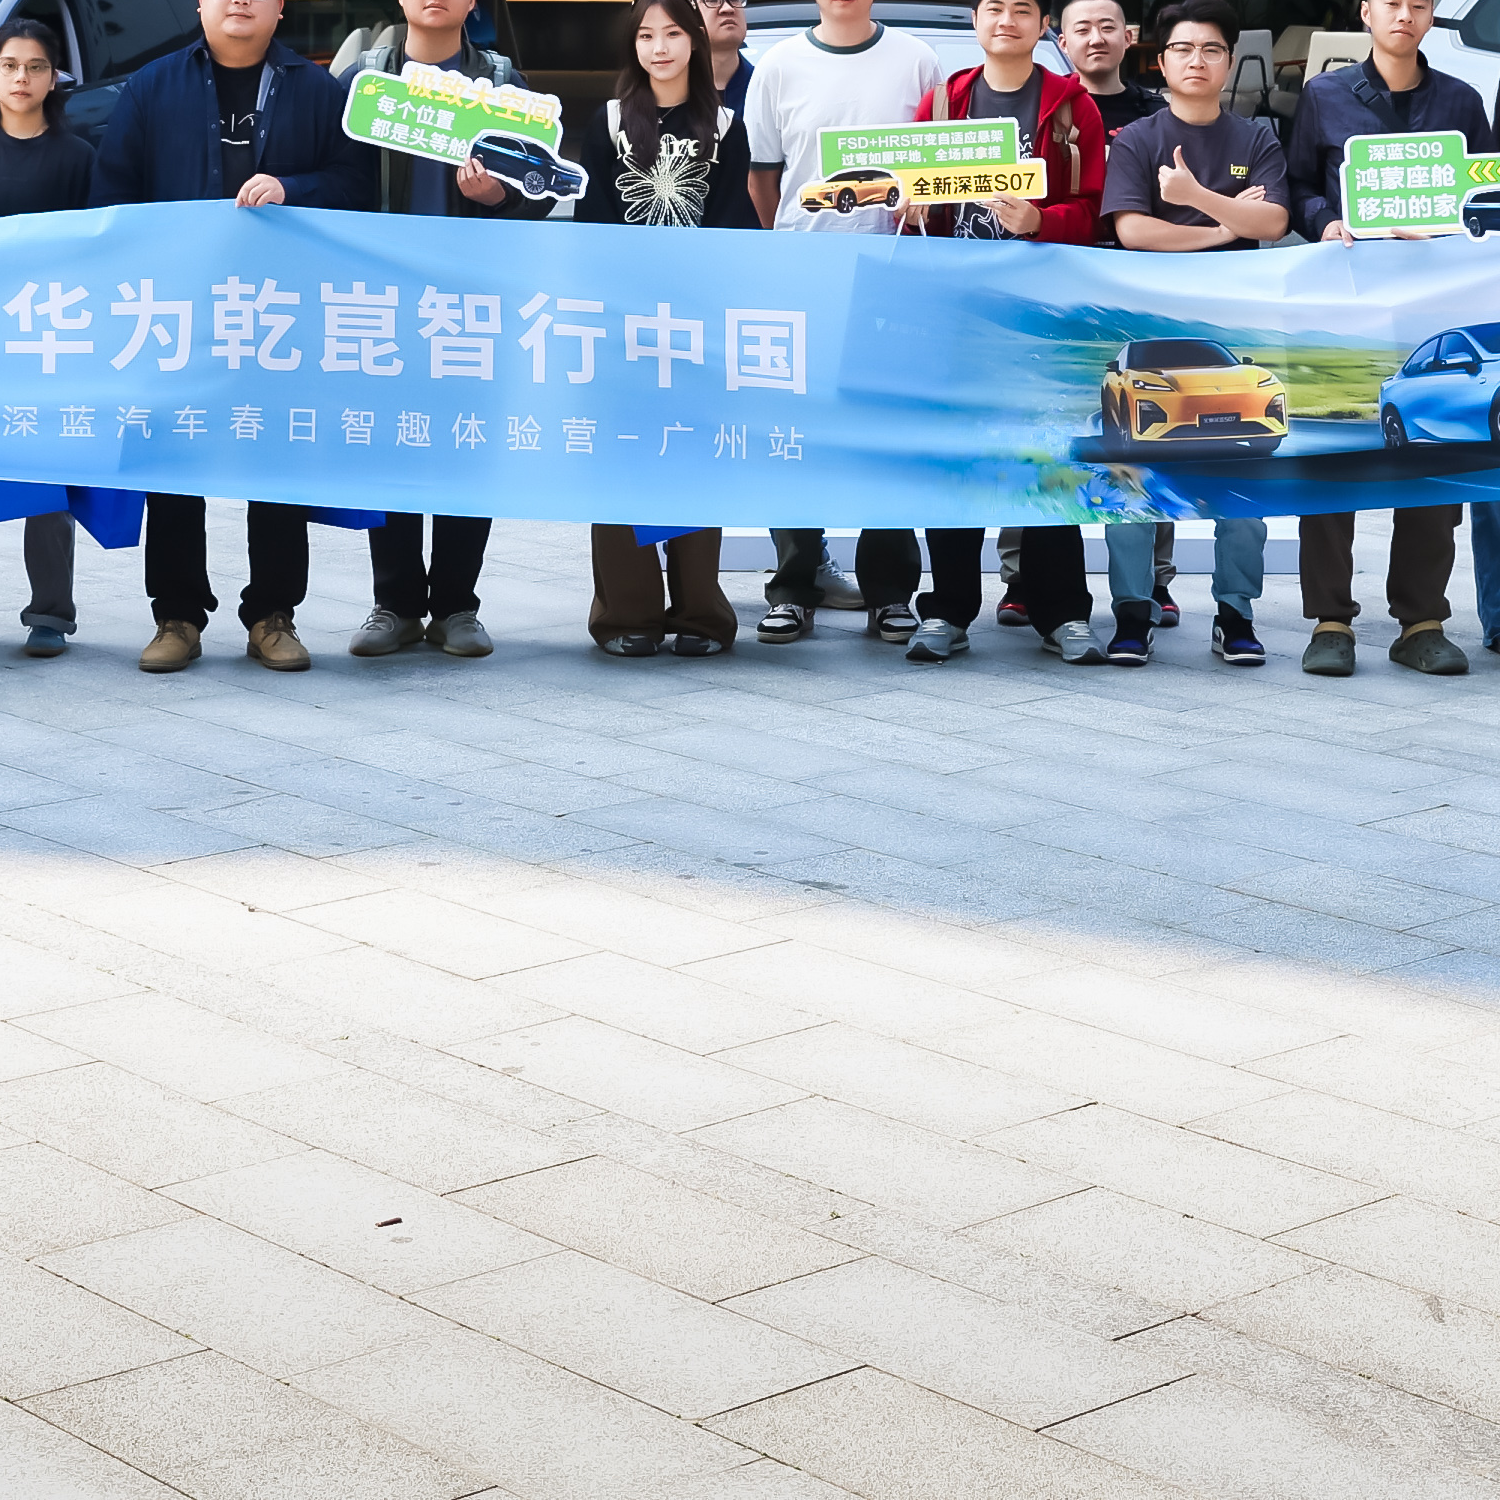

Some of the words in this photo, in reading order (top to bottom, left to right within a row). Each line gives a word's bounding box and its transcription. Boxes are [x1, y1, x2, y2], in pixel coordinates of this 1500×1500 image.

[407, 67, 556, 130] 极致大空间
[375, 94, 454, 132] 每个位置
[369, 117, 469, 160] 都是头等舱
[837, 129, 1005, 151] FSD+HRS可变自适应悬架
[1367, 141, 1444, 162] 深蓝S09
[912, 172, 1037, 197] 全新深蓝S07
[1355, 164, 1457, 191] 鸿蒙座舱
[1356, 194, 1459, 222] 移动的家
[2, 276, 808, 394] 华为乾崑智行中国
